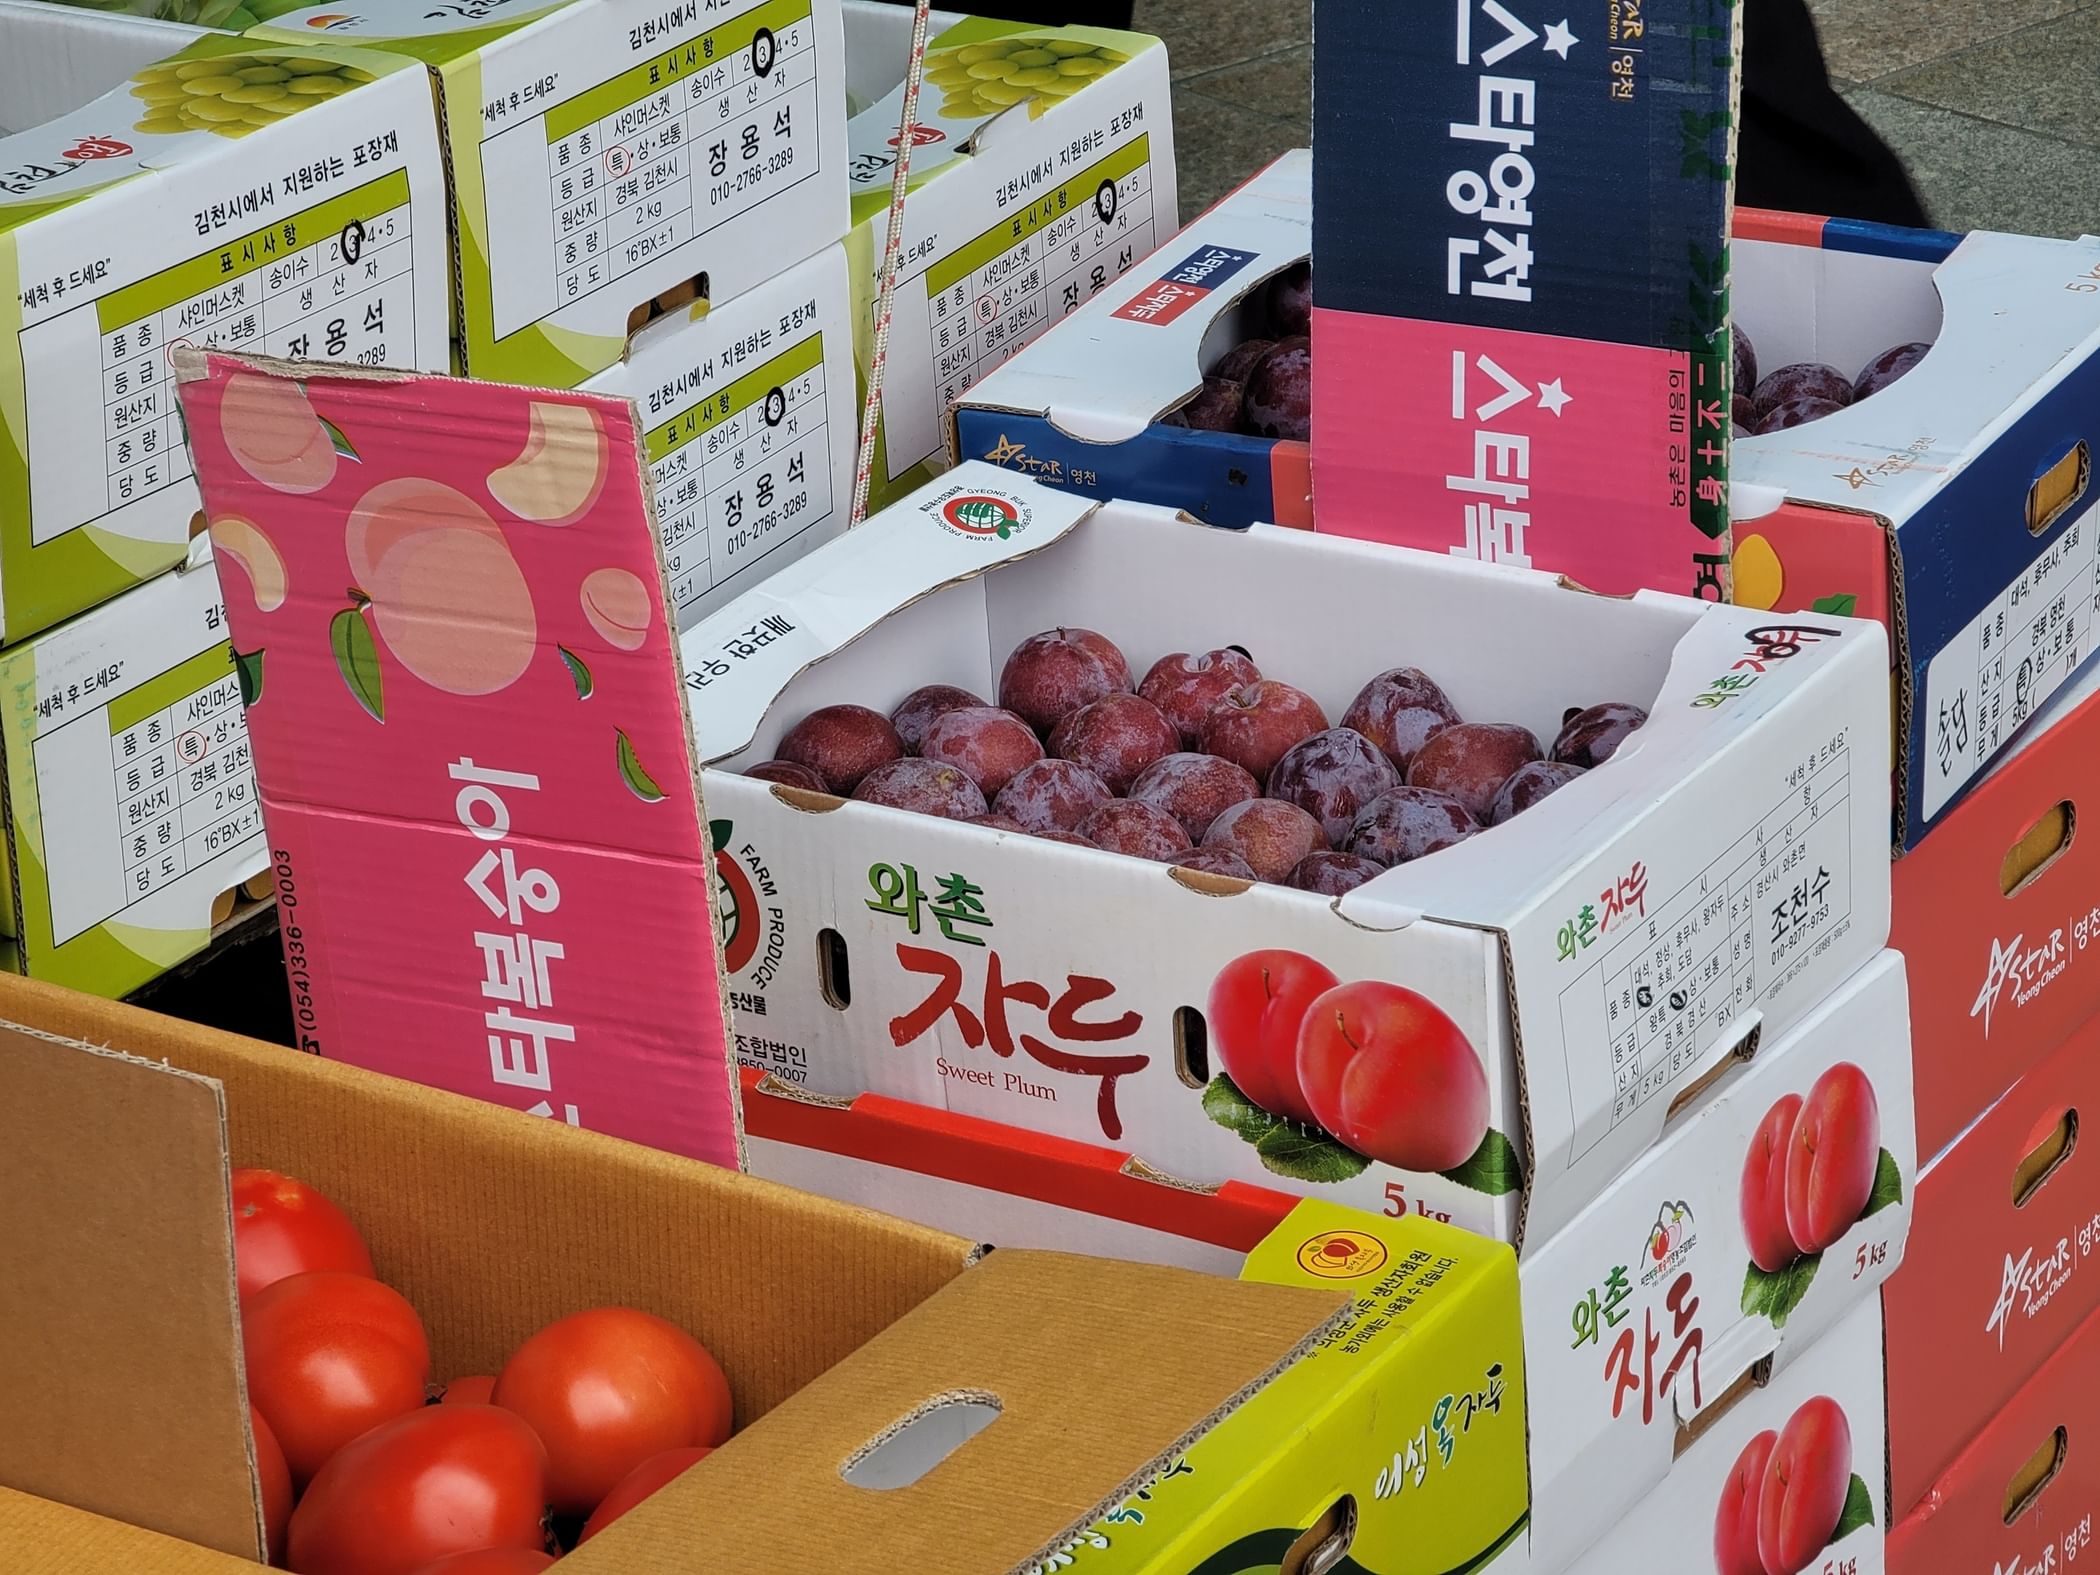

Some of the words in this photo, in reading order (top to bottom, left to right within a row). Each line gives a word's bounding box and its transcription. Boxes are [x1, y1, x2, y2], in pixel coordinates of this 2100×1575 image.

[690, 67, 726, 98] 송이수
[1611, 55, 1635, 100] 영천
[614, 94, 671, 137] 샤인머스켓
[711, 147, 793, 206] 010-2766-3289
[995, 160, 1053, 208] 김천시에서
[1060, 127, 1104, 166] 지원하는
[1110, 101, 1144, 137] 포장재
[194, 185, 274, 235] 김천시에서
[284, 155, 344, 197] 지원하는
[353, 130, 399, 168] 포장재
[616, 178, 639, 205] 경북
[644, 158, 678, 192] 김천시
[561, 198, 598, 232] 원산지
[646, 202, 663, 222] kg
[1048, 215, 1076, 248] 송이수
[268, 259, 310, 290] 송이수
[983, 246, 1031, 287] 샤인머스켓
[1173, 250, 1230, 284] 스타영천
[178, 285, 246, 329] 샤인머스켓
[1129, 286, 1186, 320] 스타자두
[985, 325, 1005, 349] 경북
[1008, 304, 1039, 334] 김천시
[649, 358, 714, 414] 김천시에서
[722, 328, 772, 369] 지원하는
[778, 298, 817, 338] 포장재
[940, 347, 972, 377] 원산지
[114, 394, 157, 430] 원산지
[1669, 369, 1685, 432] 마음의
[707, 421, 741, 454] 송이수
[1070, 469, 1097, 486] 영천
[1669, 445, 1685, 508] 농촌은
[727, 491, 807, 555] 010-2766-3289
[723, 614, 796, 660] 깨끗한
[191, 762, 217, 791] 경북
[227, 782, 245, 804] kg
[128, 786, 169, 825] 원산지
[740, 844, 777, 896] FARM
[864, 862, 993, 946] 와촌
[1557, 904, 1598, 962] 와촌
[1600, 861, 1648, 933] 자두
[1771, 864, 1831, 944] 조천수
[274, 849, 318, 1032] (054)336-0003
[448, 756, 580, 1128] 타복숭아
[750, 907, 785, 991] PRODUCE
[1771, 904, 1829, 965] 010-9277-9753
[889, 942, 1150, 1140] 자두
[936, 1058, 995, 1088] Sweet
[1003, 1073, 1057, 1102] Plum
[1383, 1182, 1406, 1219] 5
[1371, 1250, 1432, 1297] 생산자회원
[1853, 1242, 1868, 1280] 5
[1870, 1240, 1888, 1267] kg
[1407, 1287, 1424, 1296] 수
[1571, 1265, 1633, 1350] 와촌
[1604, 1272, 1702, 1425] 자두
